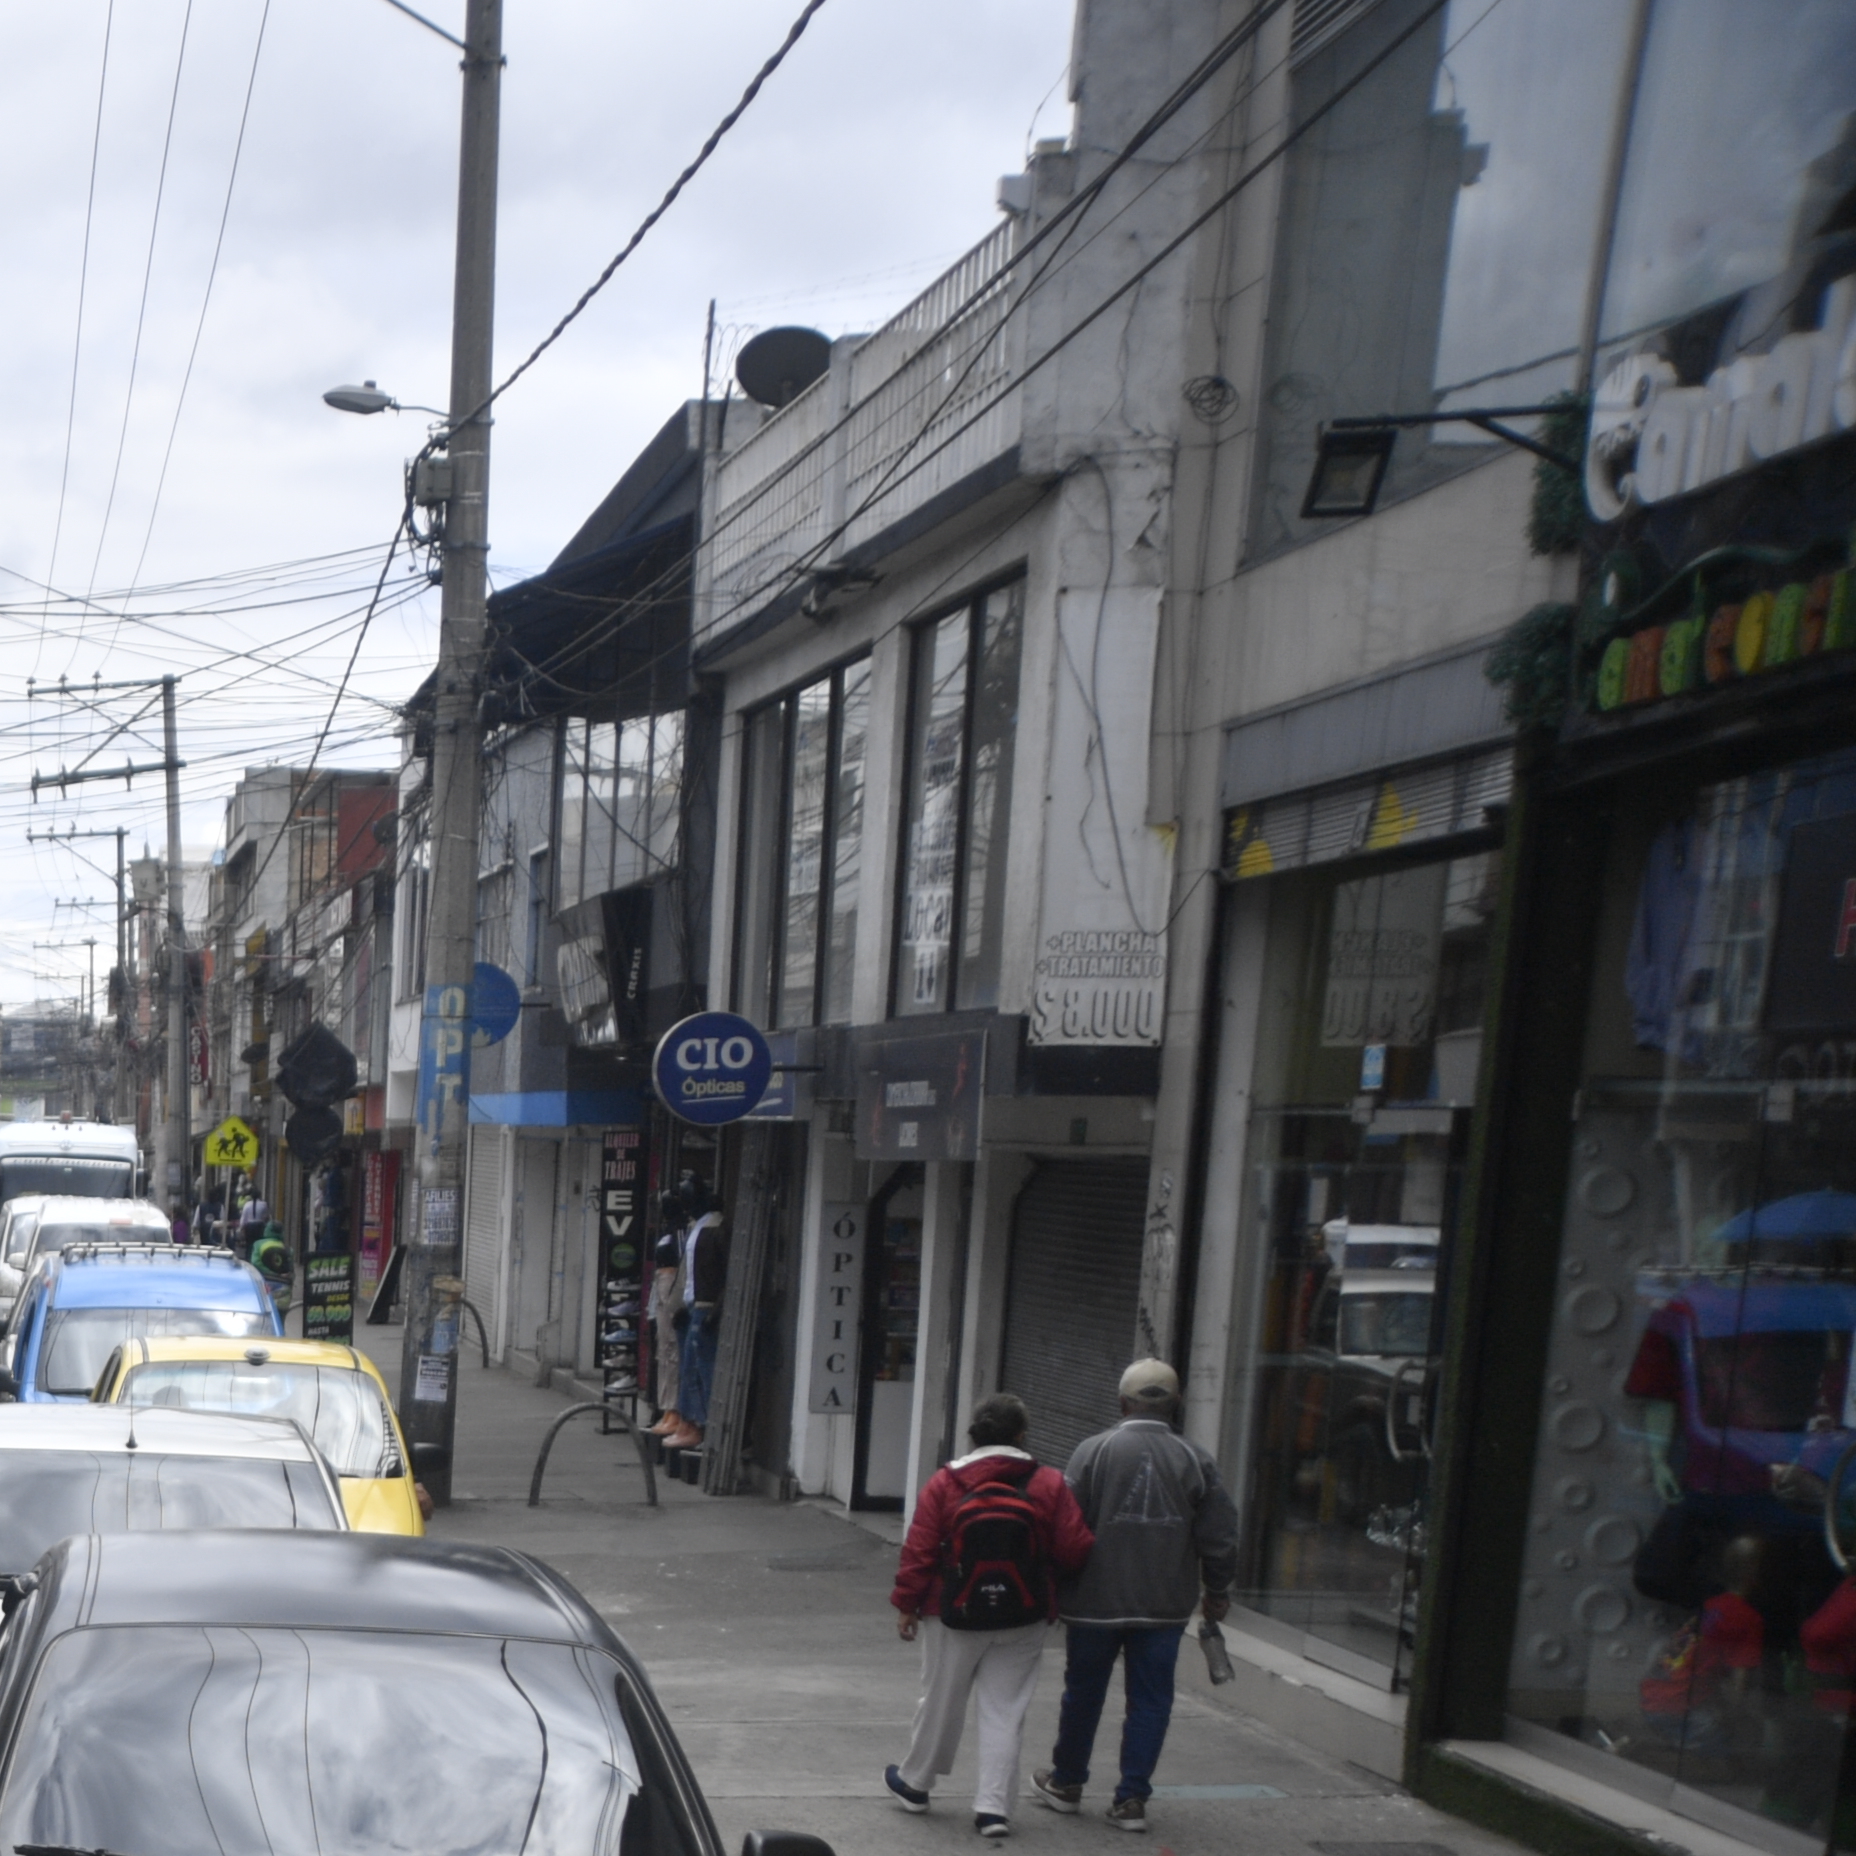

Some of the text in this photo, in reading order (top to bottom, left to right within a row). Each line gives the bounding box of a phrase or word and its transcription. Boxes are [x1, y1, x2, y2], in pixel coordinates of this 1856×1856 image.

[1035, 954, 1165, 978] +TRATAMIENTO
[1061, 988, 1155, 1040] 8.000
[675, 1035, 754, 1071] CIO
[681, 1075, 746, 1098] Ópticas
[307, 1256, 349, 1279] SALE
[311, 1279, 351, 1295] TENNIS
[824, 1209, 859, 1409] ÓPTICA
